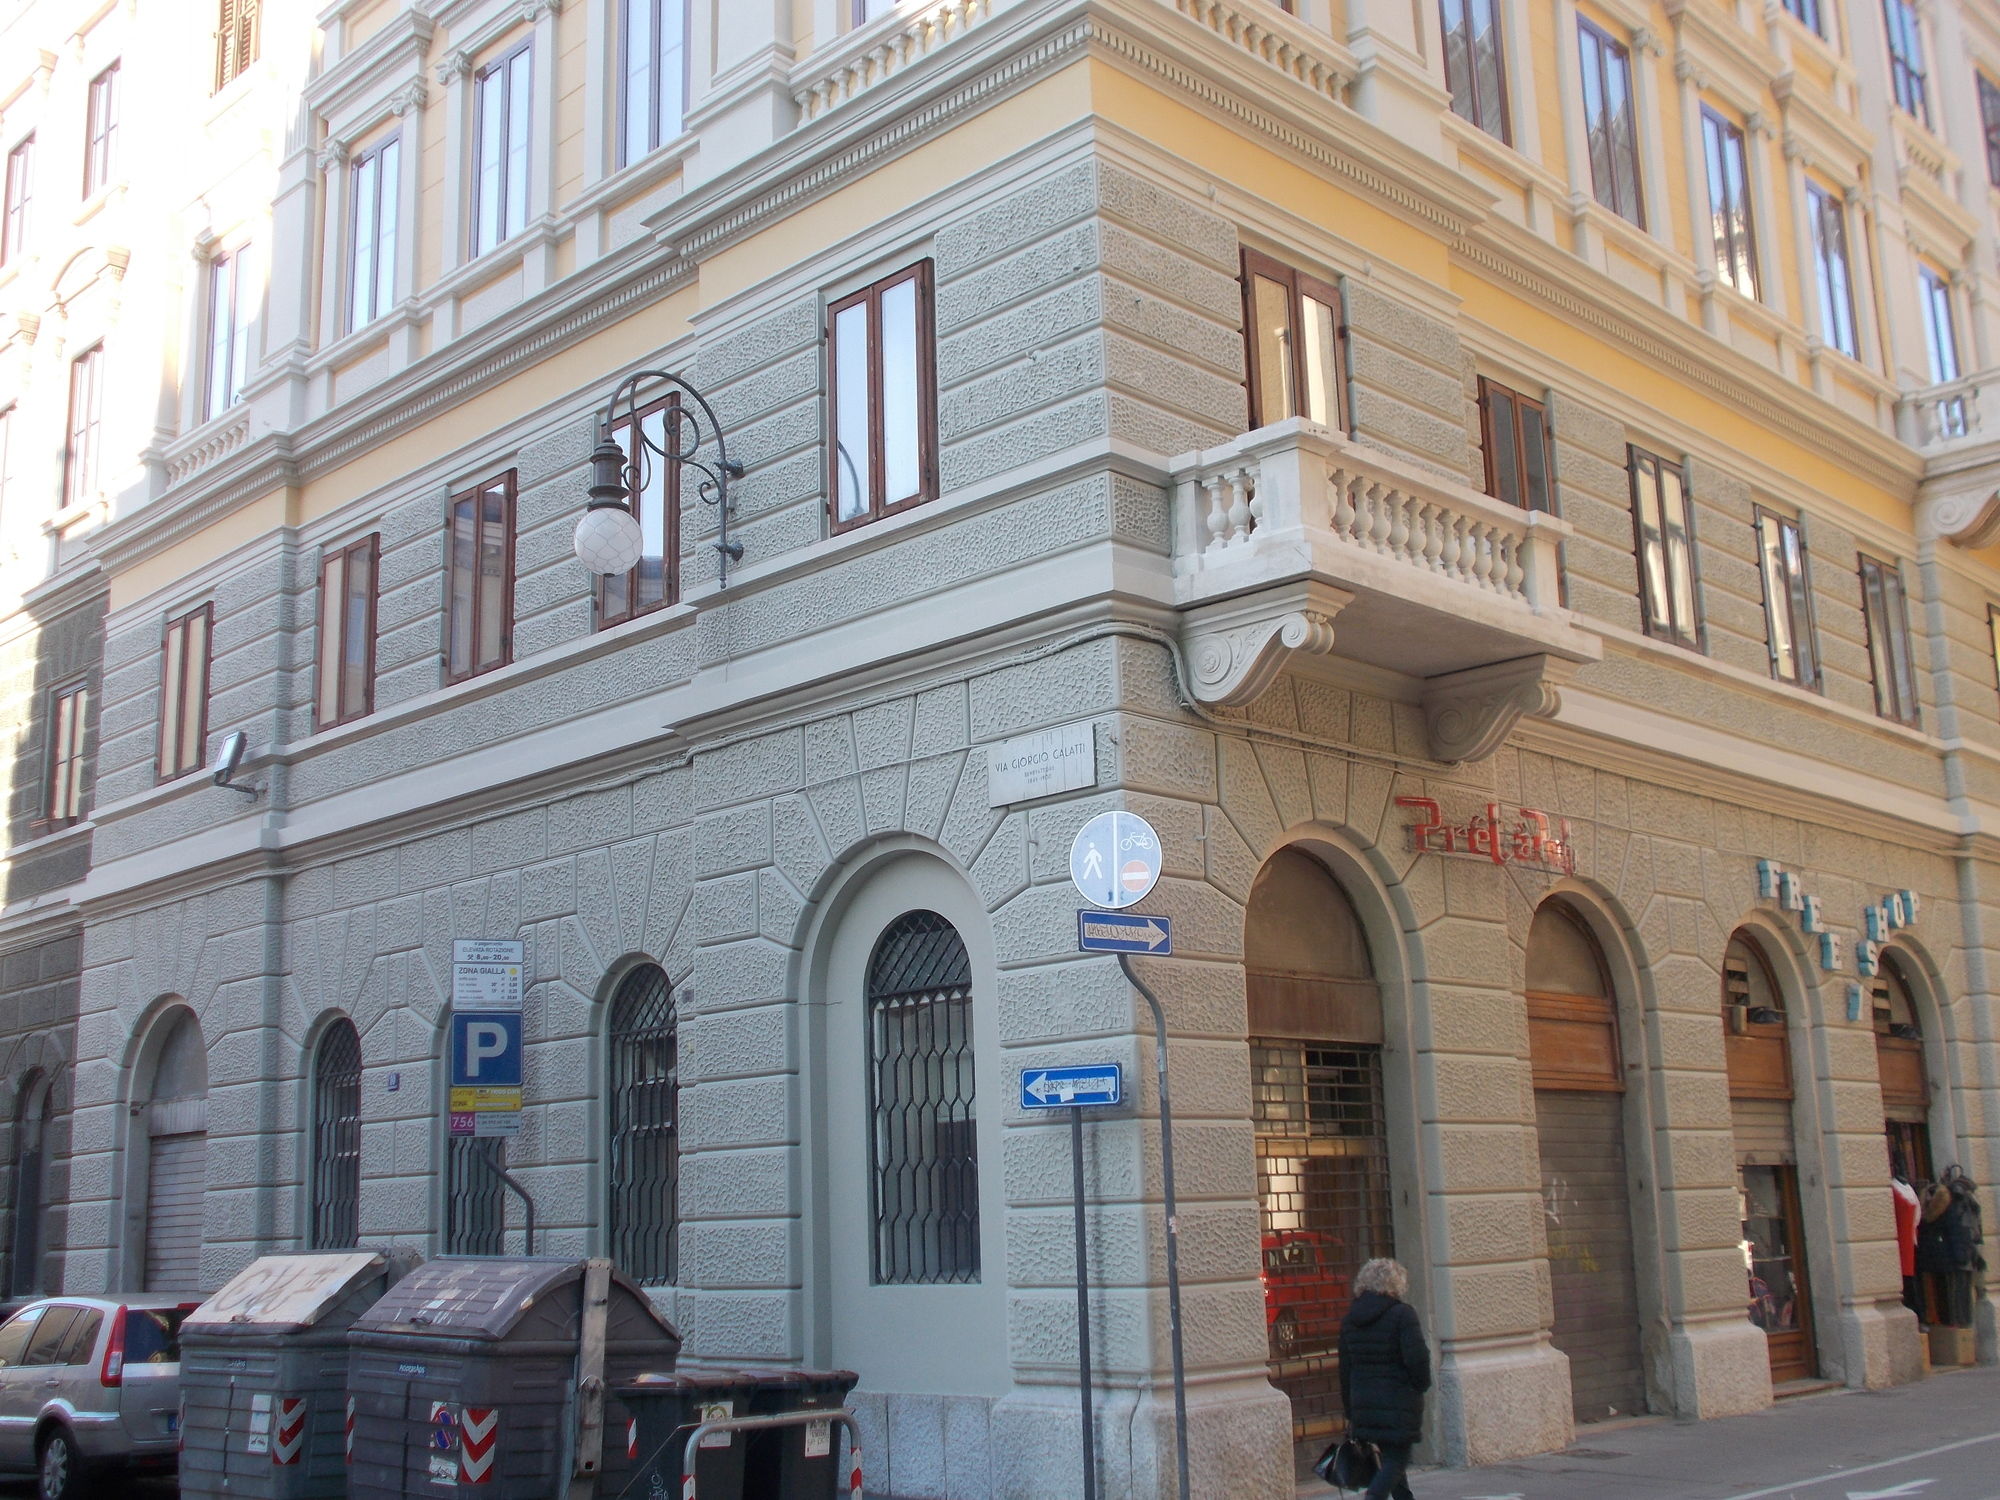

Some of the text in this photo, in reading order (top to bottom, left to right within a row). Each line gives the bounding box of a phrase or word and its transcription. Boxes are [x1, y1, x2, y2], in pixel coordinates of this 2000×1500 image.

[995, 762, 1009, 773] VIA
[1011, 751, 1049, 769] GIORGIO
[1052, 743, 1086, 760] GALATTI
[1758, 860, 1843, 971] FREE
[1856, 890, 1921, 977] SHOP
[480, 967, 506, 975] GIALLA
[466, 1022, 508, 1077] P
[452, 1116, 474, 1128] 756
